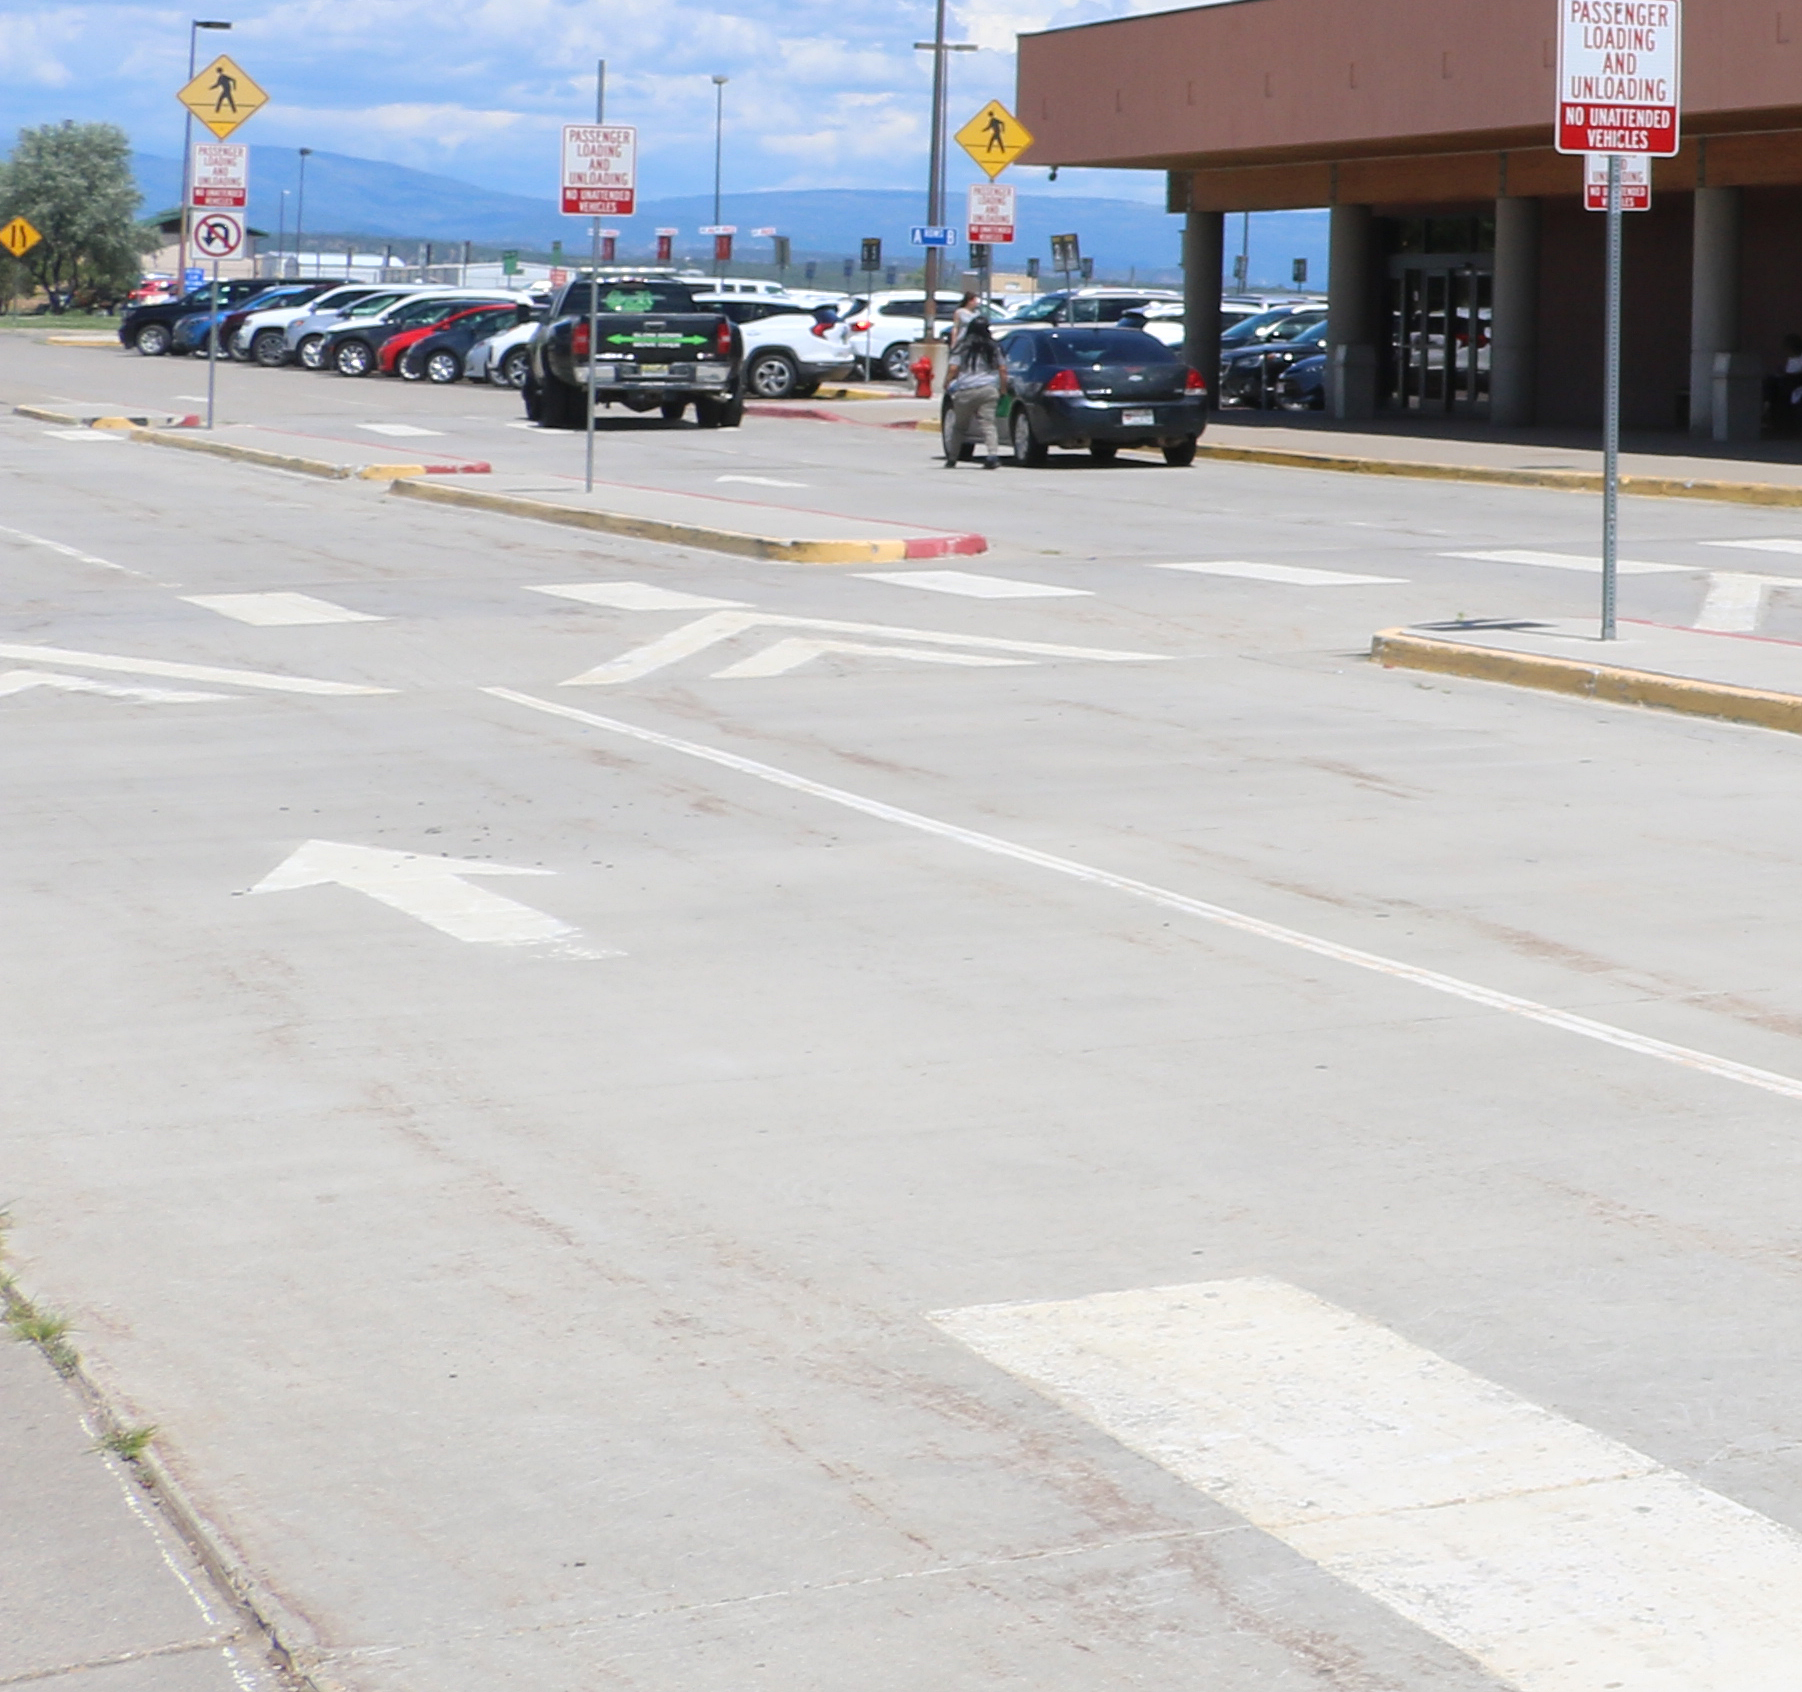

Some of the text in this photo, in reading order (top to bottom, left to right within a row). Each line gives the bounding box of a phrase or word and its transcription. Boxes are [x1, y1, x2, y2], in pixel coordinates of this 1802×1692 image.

[1570, 0, 1669, 27] PASSENGER
[1583, 25, 1656, 52] LOADING
[1602, 51, 1638, 76] AND
[1570, 75, 1667, 102] UNLOADING
[1565, 106, 1671, 129] NO UNATTENDED
[569, 129, 631, 144] PASSENGER
[1586, 128, 1650, 150] VEHICLES
[577, 144, 622, 158] LOADING
[588, 158, 610, 171] AND
[569, 172, 629, 186] UNLOADING
[565, 189, 632, 201] NO UNATTENDED
[1590, 186, 1600, 197] NO
[578, 201, 618, 213] VEHICLES
[913, 229, 922, 244] A
[946, 229, 955, 245] B
